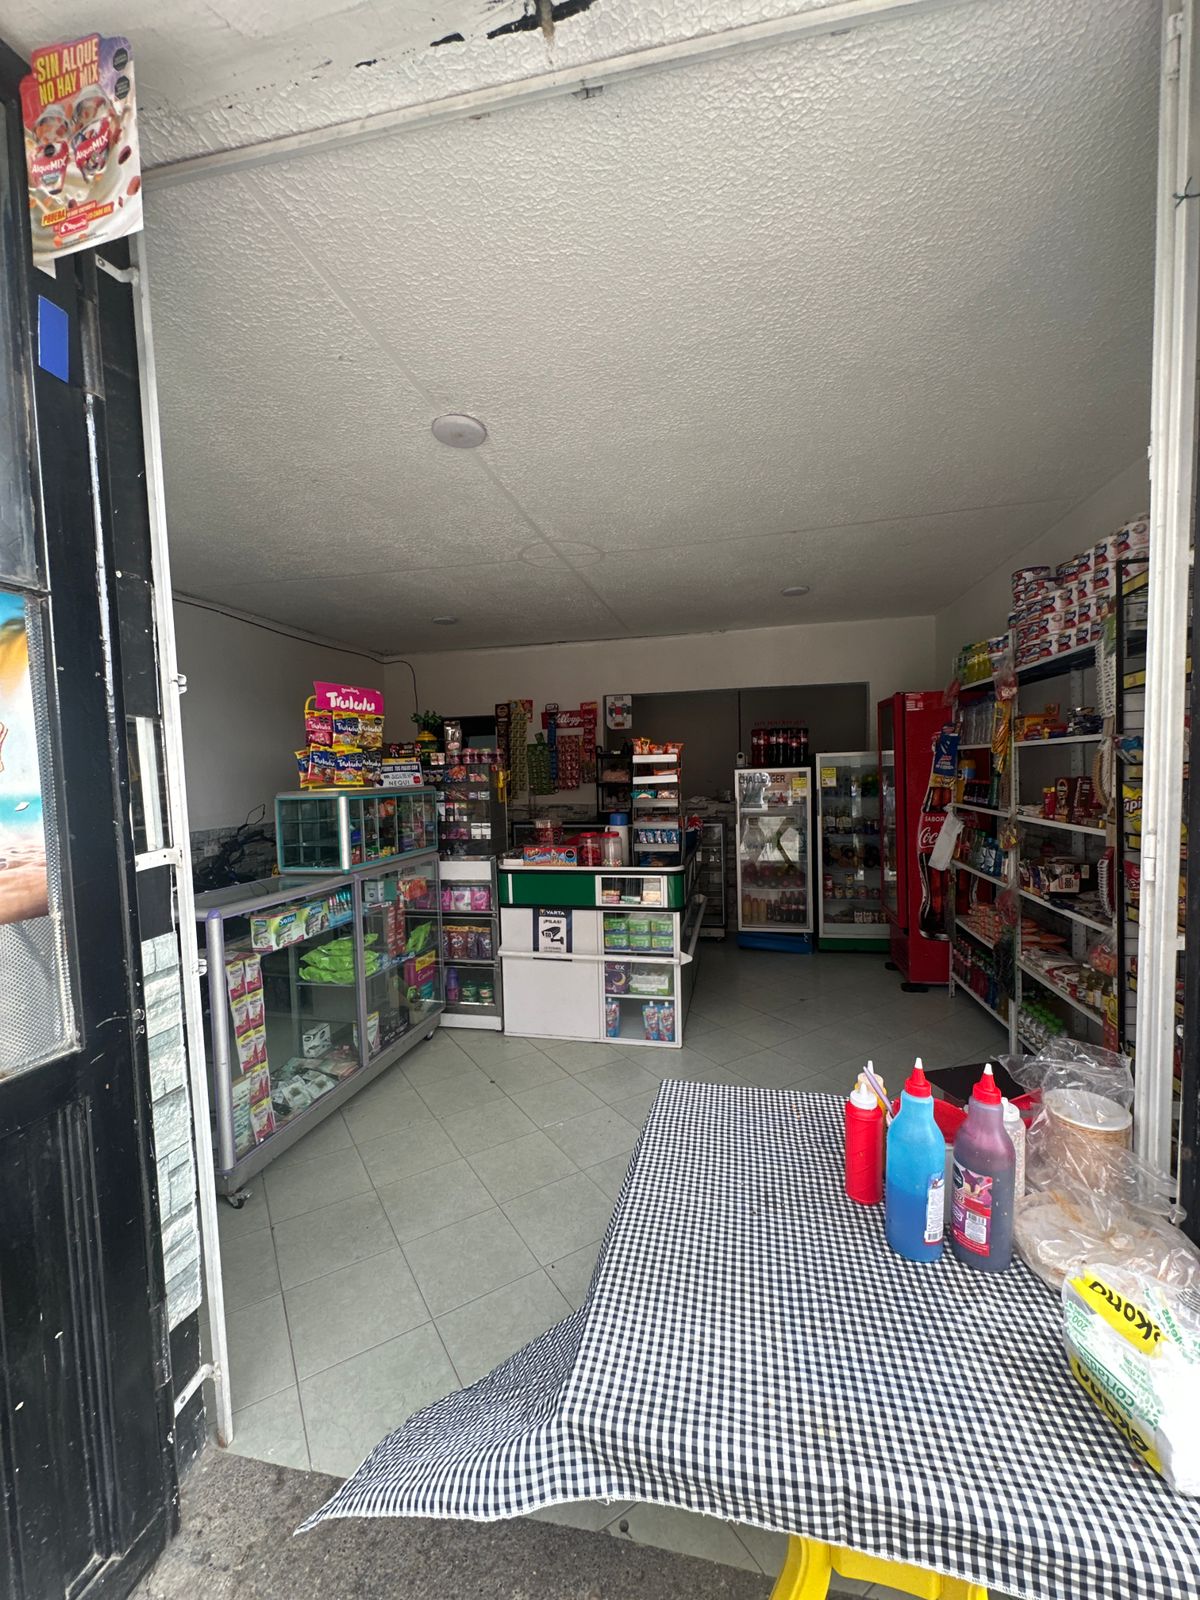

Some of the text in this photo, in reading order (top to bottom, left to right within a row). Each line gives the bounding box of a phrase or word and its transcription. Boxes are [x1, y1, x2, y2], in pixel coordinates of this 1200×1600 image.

[36, 52, 60, 83] SIN
[62, 38, 98, 73] ALQUE
[39, 80, 55, 106] NO
[57, 71, 77, 98] HAY
[79, 62, 98, 88] MIX
[326, 692, 375, 711] Trululu
[1072, 1315, 1089, 1332] 200
